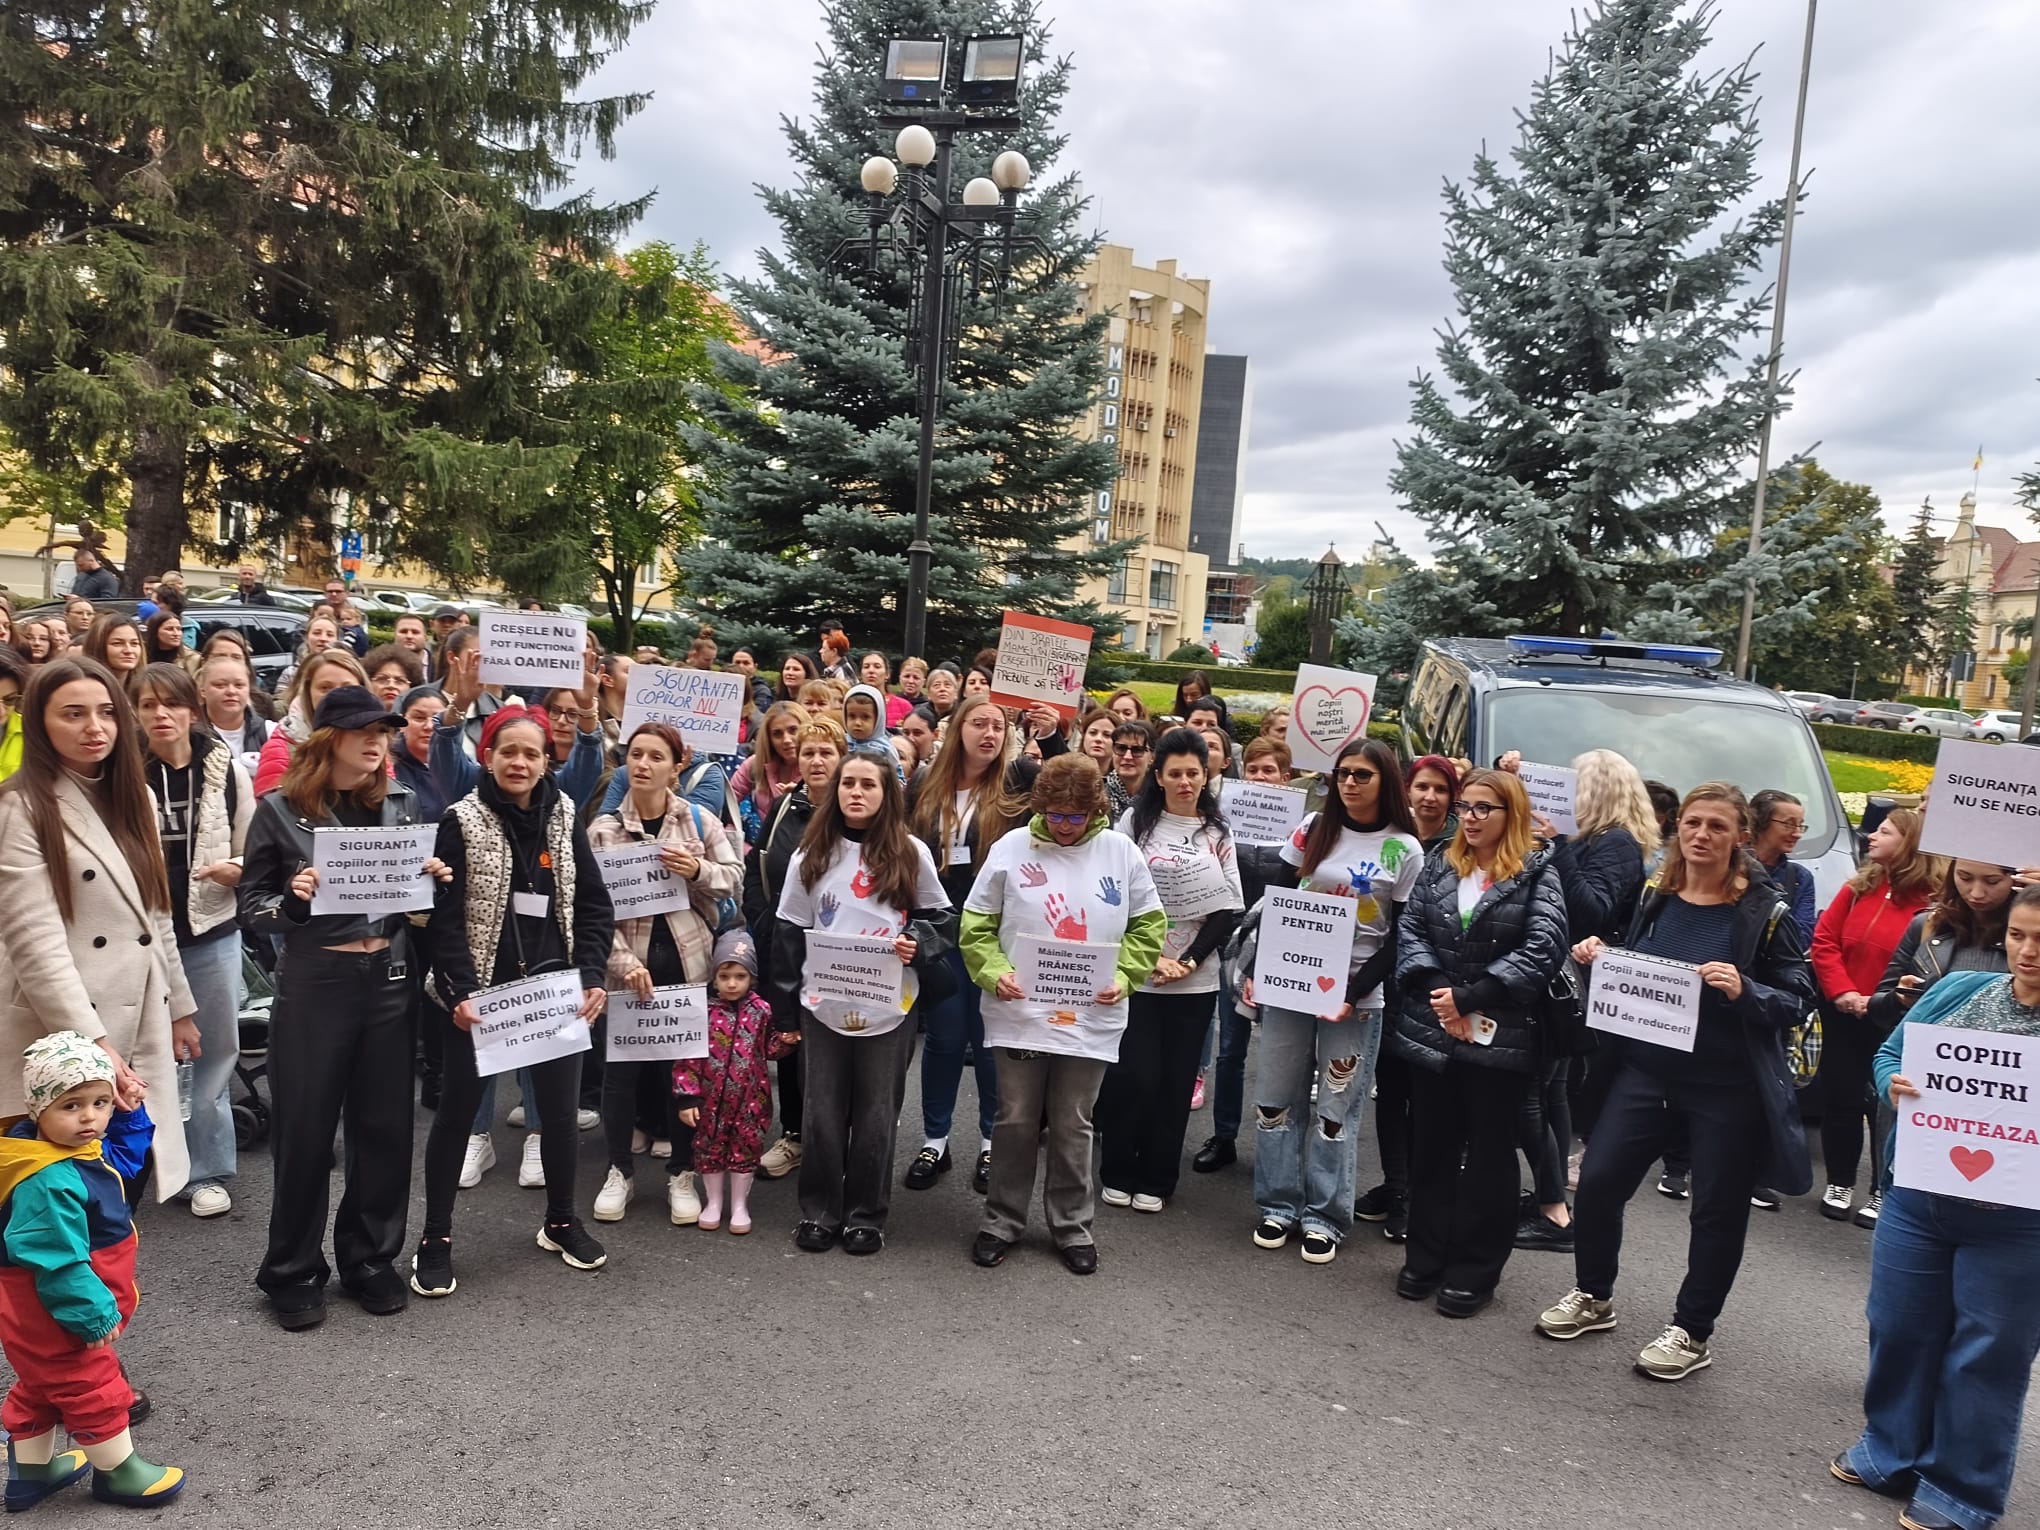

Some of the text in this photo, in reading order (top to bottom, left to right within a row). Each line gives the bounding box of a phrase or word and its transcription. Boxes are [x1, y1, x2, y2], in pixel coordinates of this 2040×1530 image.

[491, 624, 577, 637] CREȘELE NU
[1004, 627, 1024, 640] DIN
[490, 640, 575, 652] POT FUNCȚIONA
[483, 656, 580, 670] FĂRĂ OAMENI!
[995, 668, 1030, 685] TREBUIE
[696, 698, 719, 713] NU
[1318, 698, 1342, 709] Copiii
[1318, 707, 1344, 718] noștri
[645, 712, 731, 733] SE NEGOCIAZĂ
[1310, 725, 1350, 736] mai mult!
[1518, 774, 1533, 783] NU
[1947, 773, 2037, 797] SIGURANȚA
[1232, 798, 1258, 809] DOUĂ
[1953, 794, 2040, 817] NU SE NEG
[1231, 809, 1245, 817] NU
[339, 840, 417, 852] SIGURANȚA
[327, 858, 378, 869] copiilor
[401, 856, 425, 865] este
[349, 875, 380, 884] LUX.
[385, 873, 412, 883] Este
[604, 869, 671, 890] opiilor NU
[339, 891, 412, 900] necesitate.
[614, 888, 678, 906] negociază!
[1272, 897, 1348, 918] SIGURANTA
[1281, 916, 1334, 934] PENTRU
[1038, 960, 1095, 973] HRĂNESC,
[1282, 951, 1324, 968] COPIII
[830, 963, 882, 977] ASIGURAȚI
[1602, 961, 1691, 987] Copiii au nevoie
[813, 972, 896, 991] PERSONALUL necesar
[1038, 973, 1092, 986] SCHIMBĂ,
[1264, 974, 1312, 992] NOSTRI
[818, 986, 843, 994] pentru
[1035, 985, 1093, 997] LINIȘTESC
[1602, 982, 1686, 1008] de OAMENI,
[479, 987, 574, 1016] ECONOMII pe
[625, 996, 692, 1010] VREAU SĂ
[524, 1003, 578, 1023] RISCURI
[1593, 1001, 1691, 1035] NU de reduceri!
[638, 1016, 679, 1027] FIU ÎN
[614, 1031, 701, 1045] SIGURANȚĂ!!
[1936, 1042, 2023, 1069] COPIII
[1926, 1072, 2029, 1103] NOSTRI
[1912, 1112, 2039, 1145] CONTEAZA
